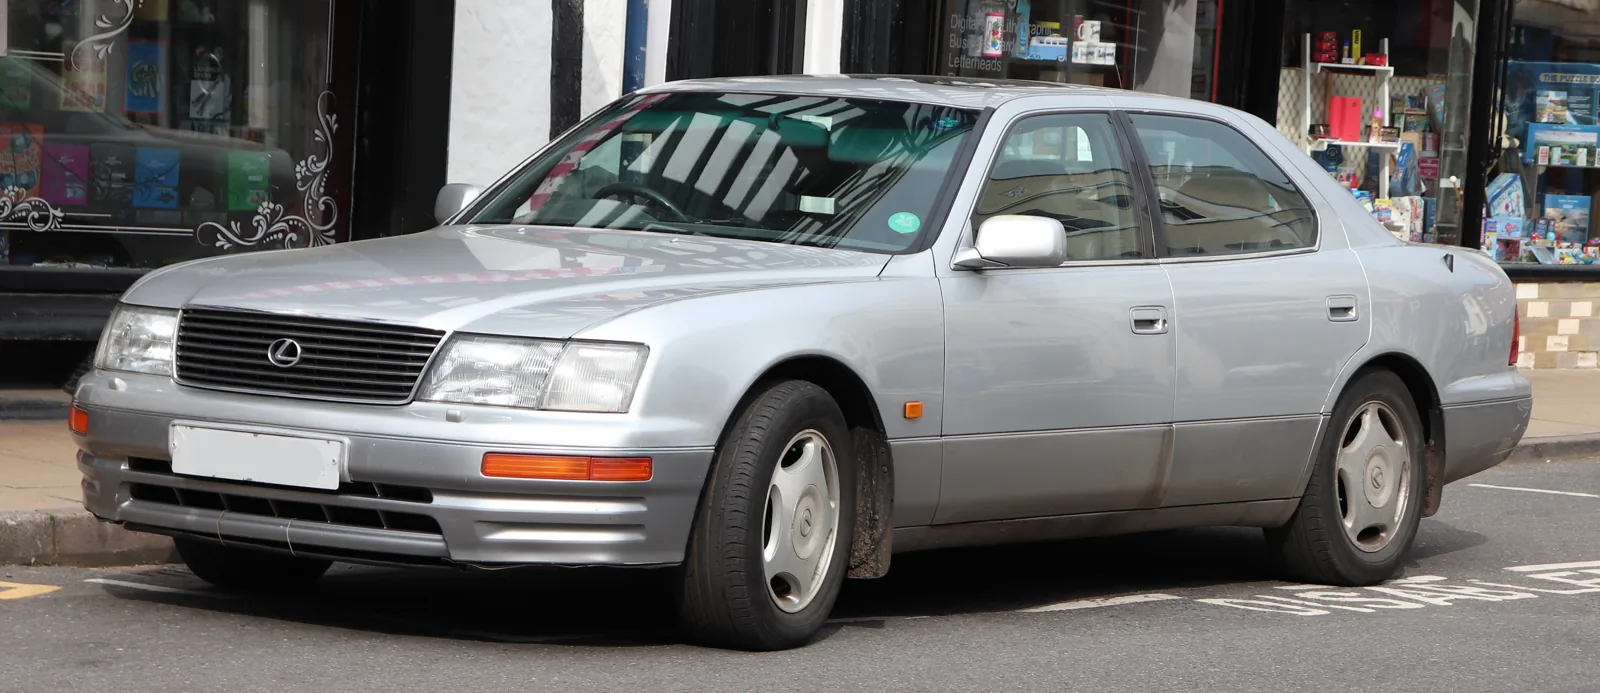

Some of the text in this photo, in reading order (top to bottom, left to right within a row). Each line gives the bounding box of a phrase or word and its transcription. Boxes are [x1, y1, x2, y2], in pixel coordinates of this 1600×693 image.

[950, 14, 977, 32] Digita
[948, 53, 1002, 71] Letterheads
[1544, 74, 1558, 82] THE
[1560, 74, 1589, 83] PUZZLE
[1195, 569, 1600, 616] DISABLE
